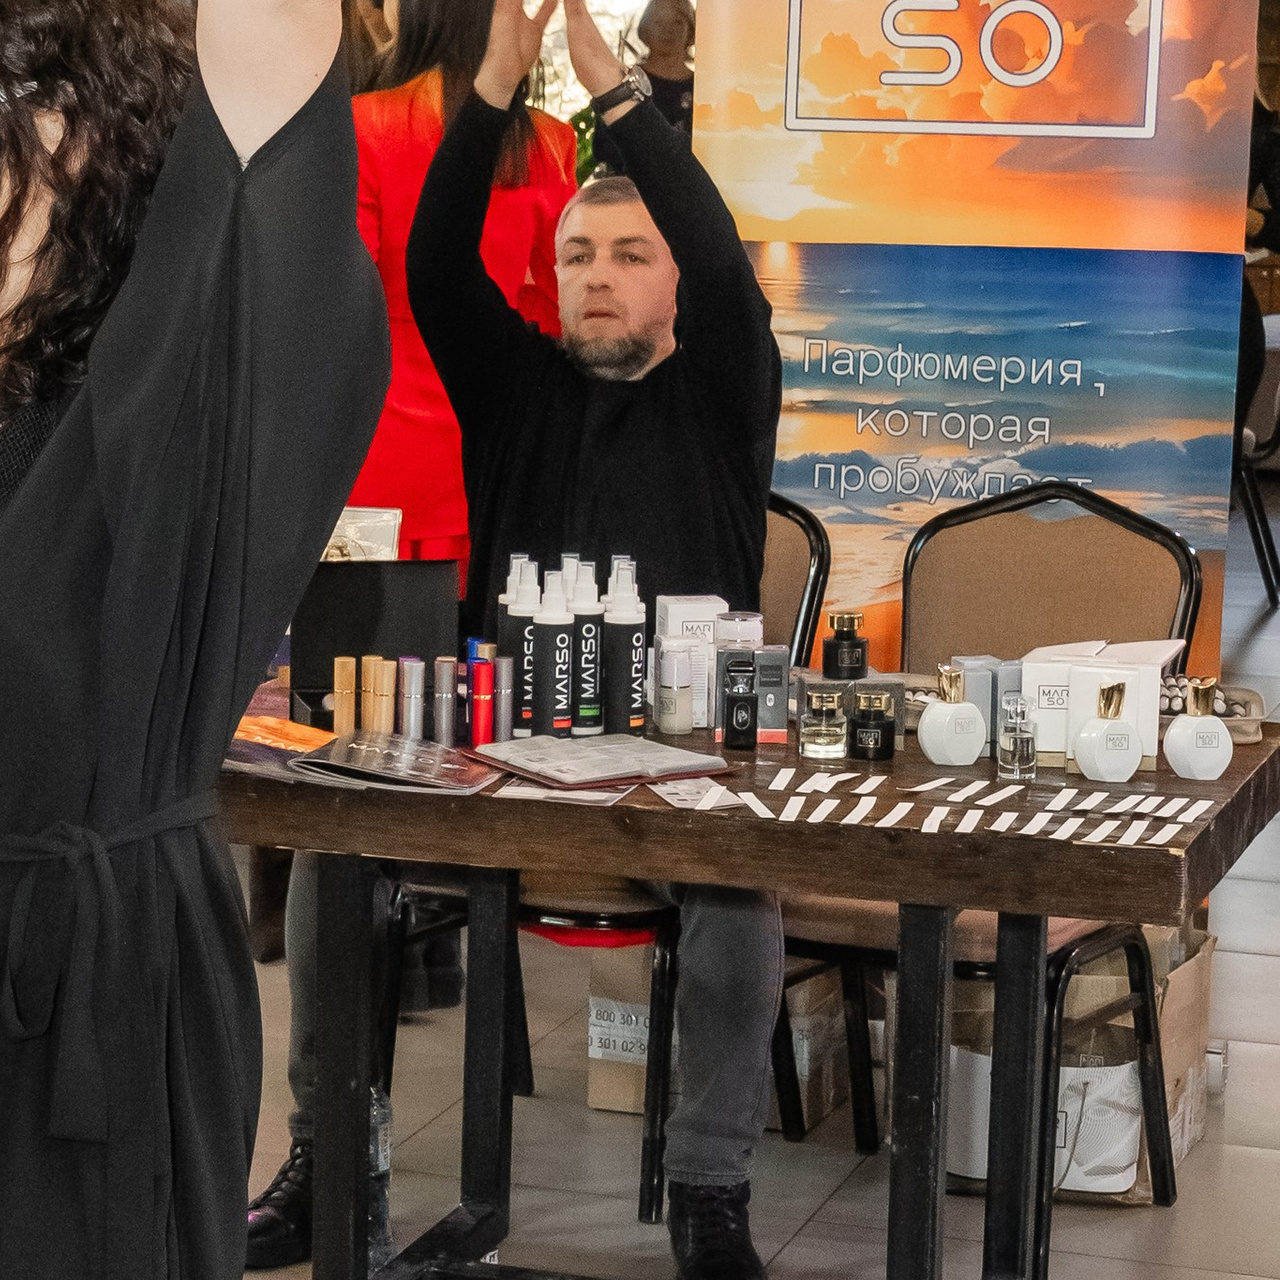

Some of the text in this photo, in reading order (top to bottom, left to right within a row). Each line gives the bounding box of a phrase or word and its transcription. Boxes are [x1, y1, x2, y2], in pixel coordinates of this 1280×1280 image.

[856, 407, 1052, 449] которая
[685, 624, 711, 632] MAR
[580, 623, 596, 698] MARSO
[555, 633, 569, 709] MARSO
[631, 632, 643, 708] MARSO
[1042, 689, 1069, 697] MAR
[1047, 697, 1064, 705] SO
[595, 1009, 616, 1023] 800
[620, 1013, 639, 1026] 301
[597, 1036, 617, 1050] 301
[621, 1040, 636, 1053] 02
